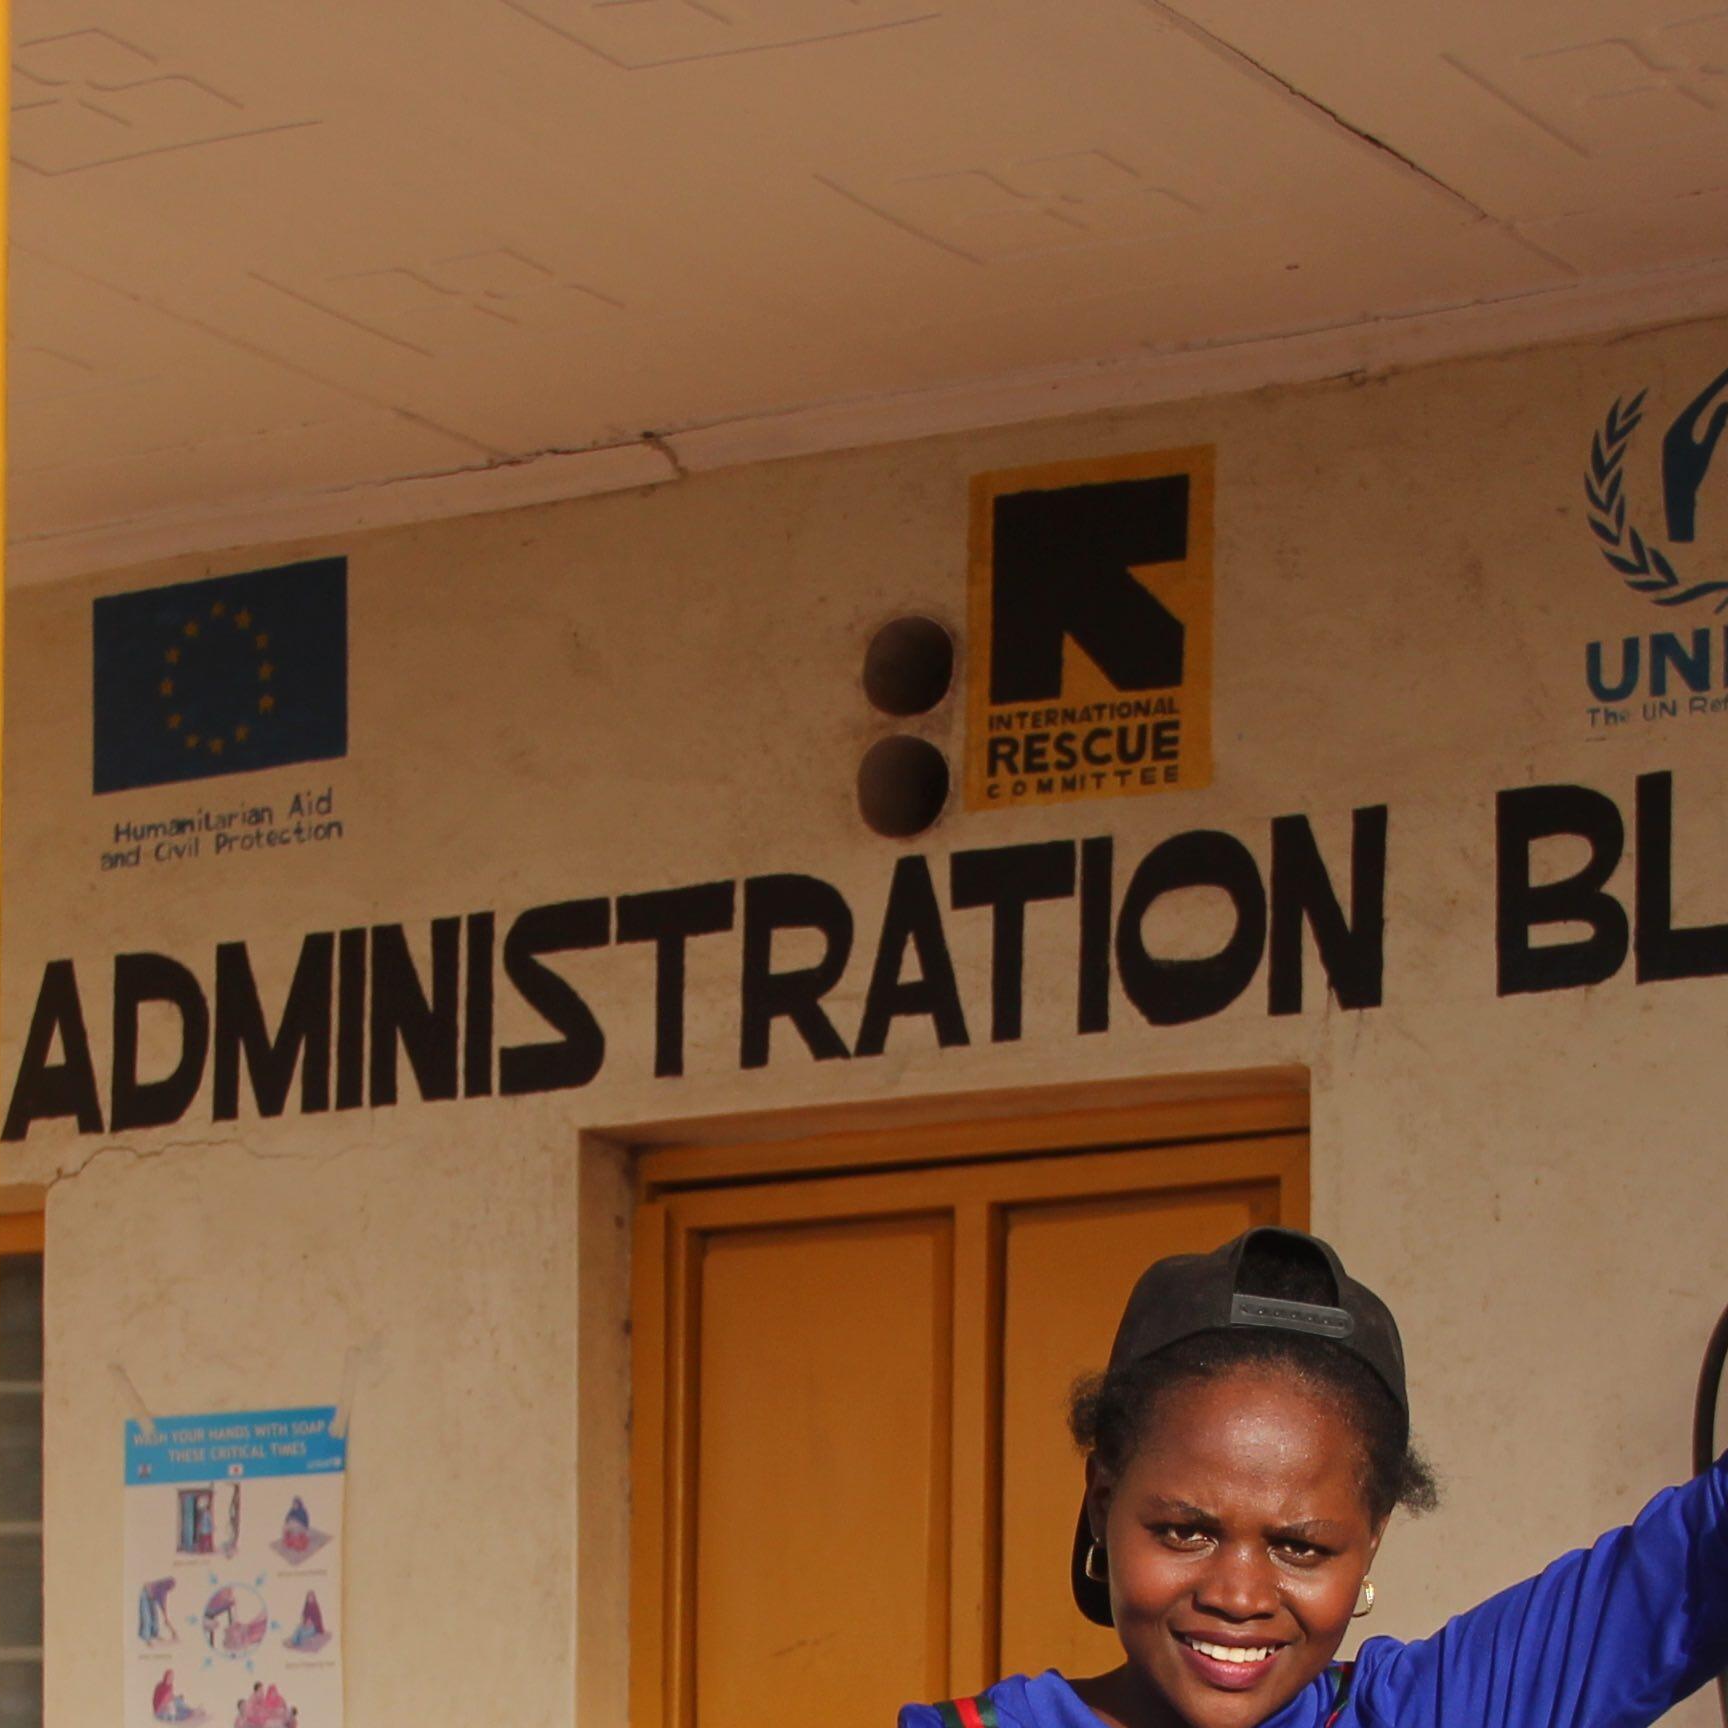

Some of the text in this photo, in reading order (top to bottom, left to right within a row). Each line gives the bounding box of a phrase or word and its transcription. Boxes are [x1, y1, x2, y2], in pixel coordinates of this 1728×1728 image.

[988, 697, 1179, 731] INTERNATIONAL
[1586, 708, 1631, 728] The
[1641, 700, 1677, 722] UN
[987, 720, 1180, 777] RESCUE
[987, 765, 1179, 799] COMMITTEE
[114, 787, 333, 843] Humanitarian Aid
[100, 819, 343, 871] and Civil Protection
[1, 804, 1388, 1141] ADMINISTRATION
[254, 1423, 288, 1437] WITH
